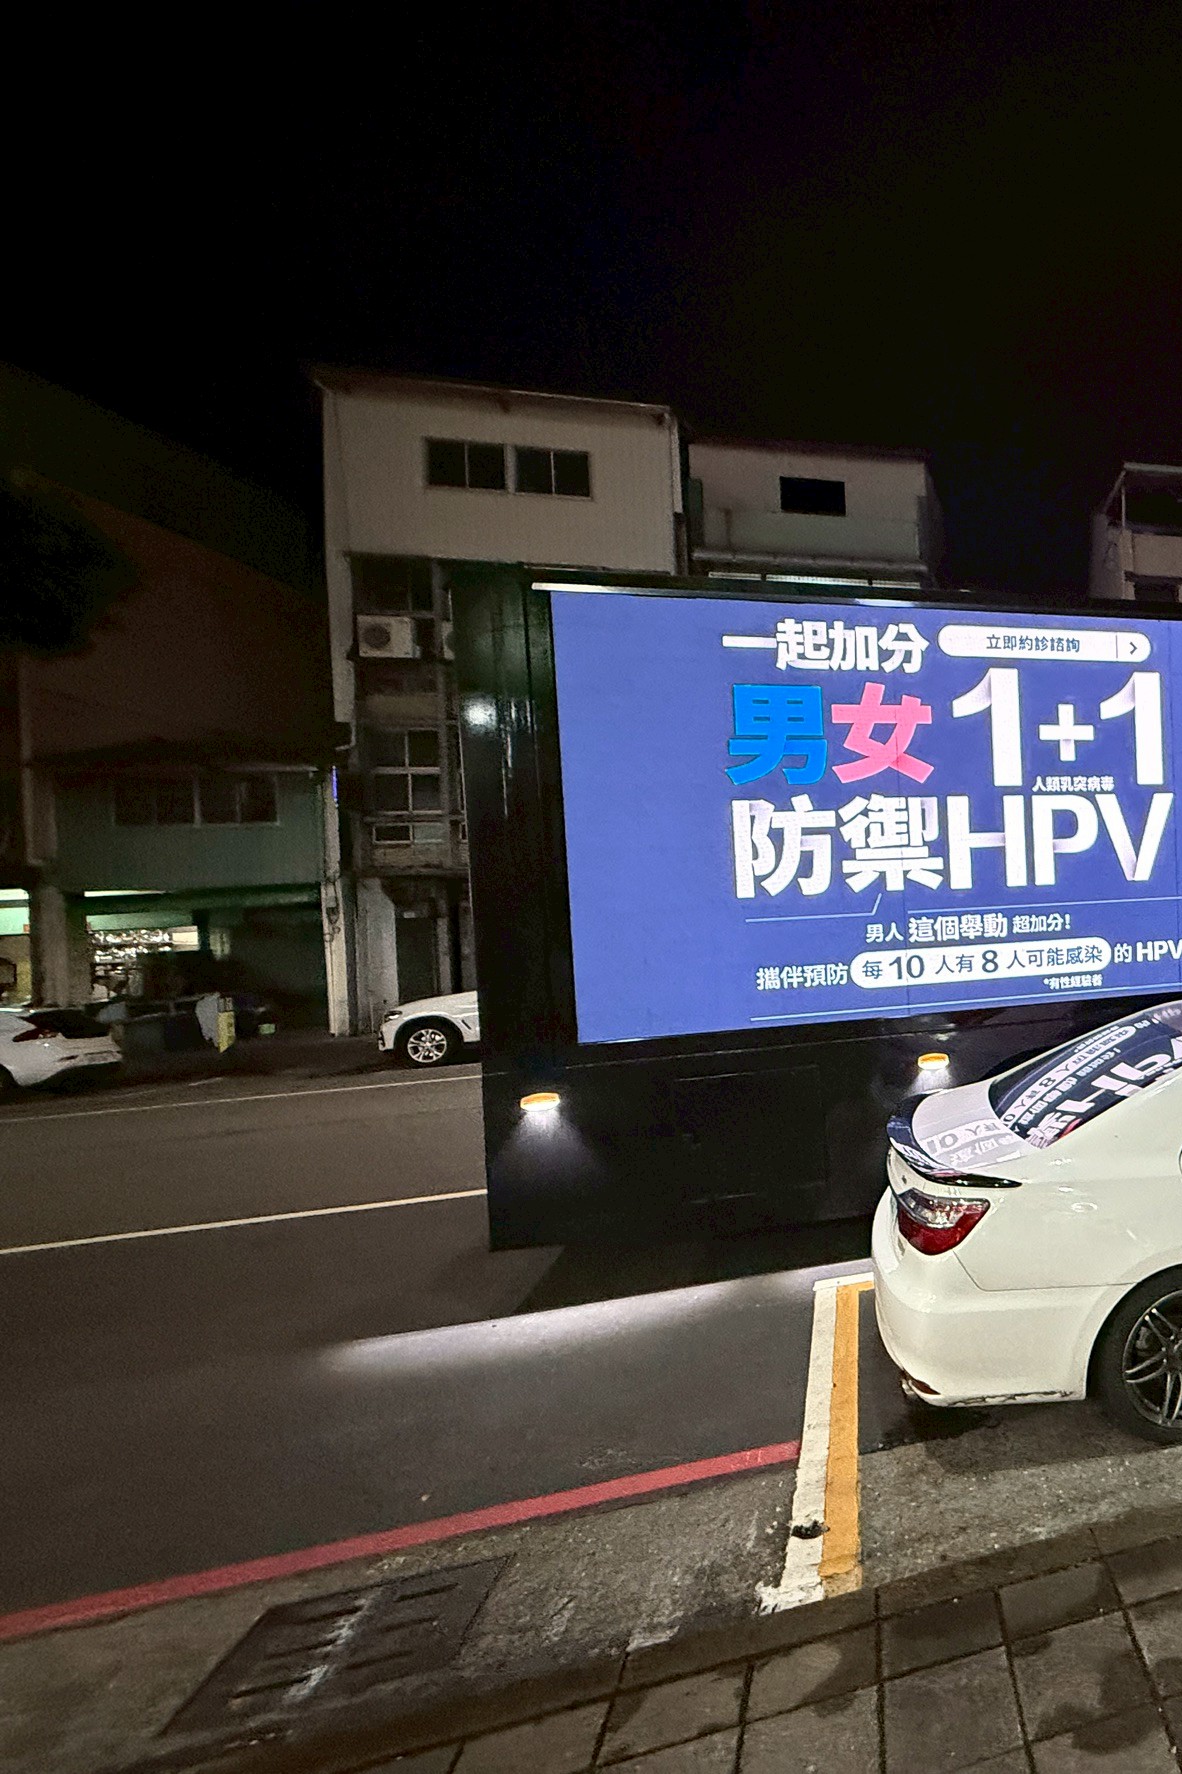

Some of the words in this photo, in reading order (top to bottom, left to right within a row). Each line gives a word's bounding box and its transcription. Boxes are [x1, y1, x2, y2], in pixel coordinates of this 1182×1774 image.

[722, 618, 930, 673] 一起加分
[985, 634, 1081, 654] 立即約診諮詢
[1031, 775, 1115, 794] 人類乳突病毒
[731, 792, 1174, 899] 防禦HPV
[866, 924, 904, 943] 男人
[908, 912, 1009, 942] 這個舉動
[756, 963, 849, 992] 攜伴預防
[1007, 943, 1103, 970] 人可能感染
